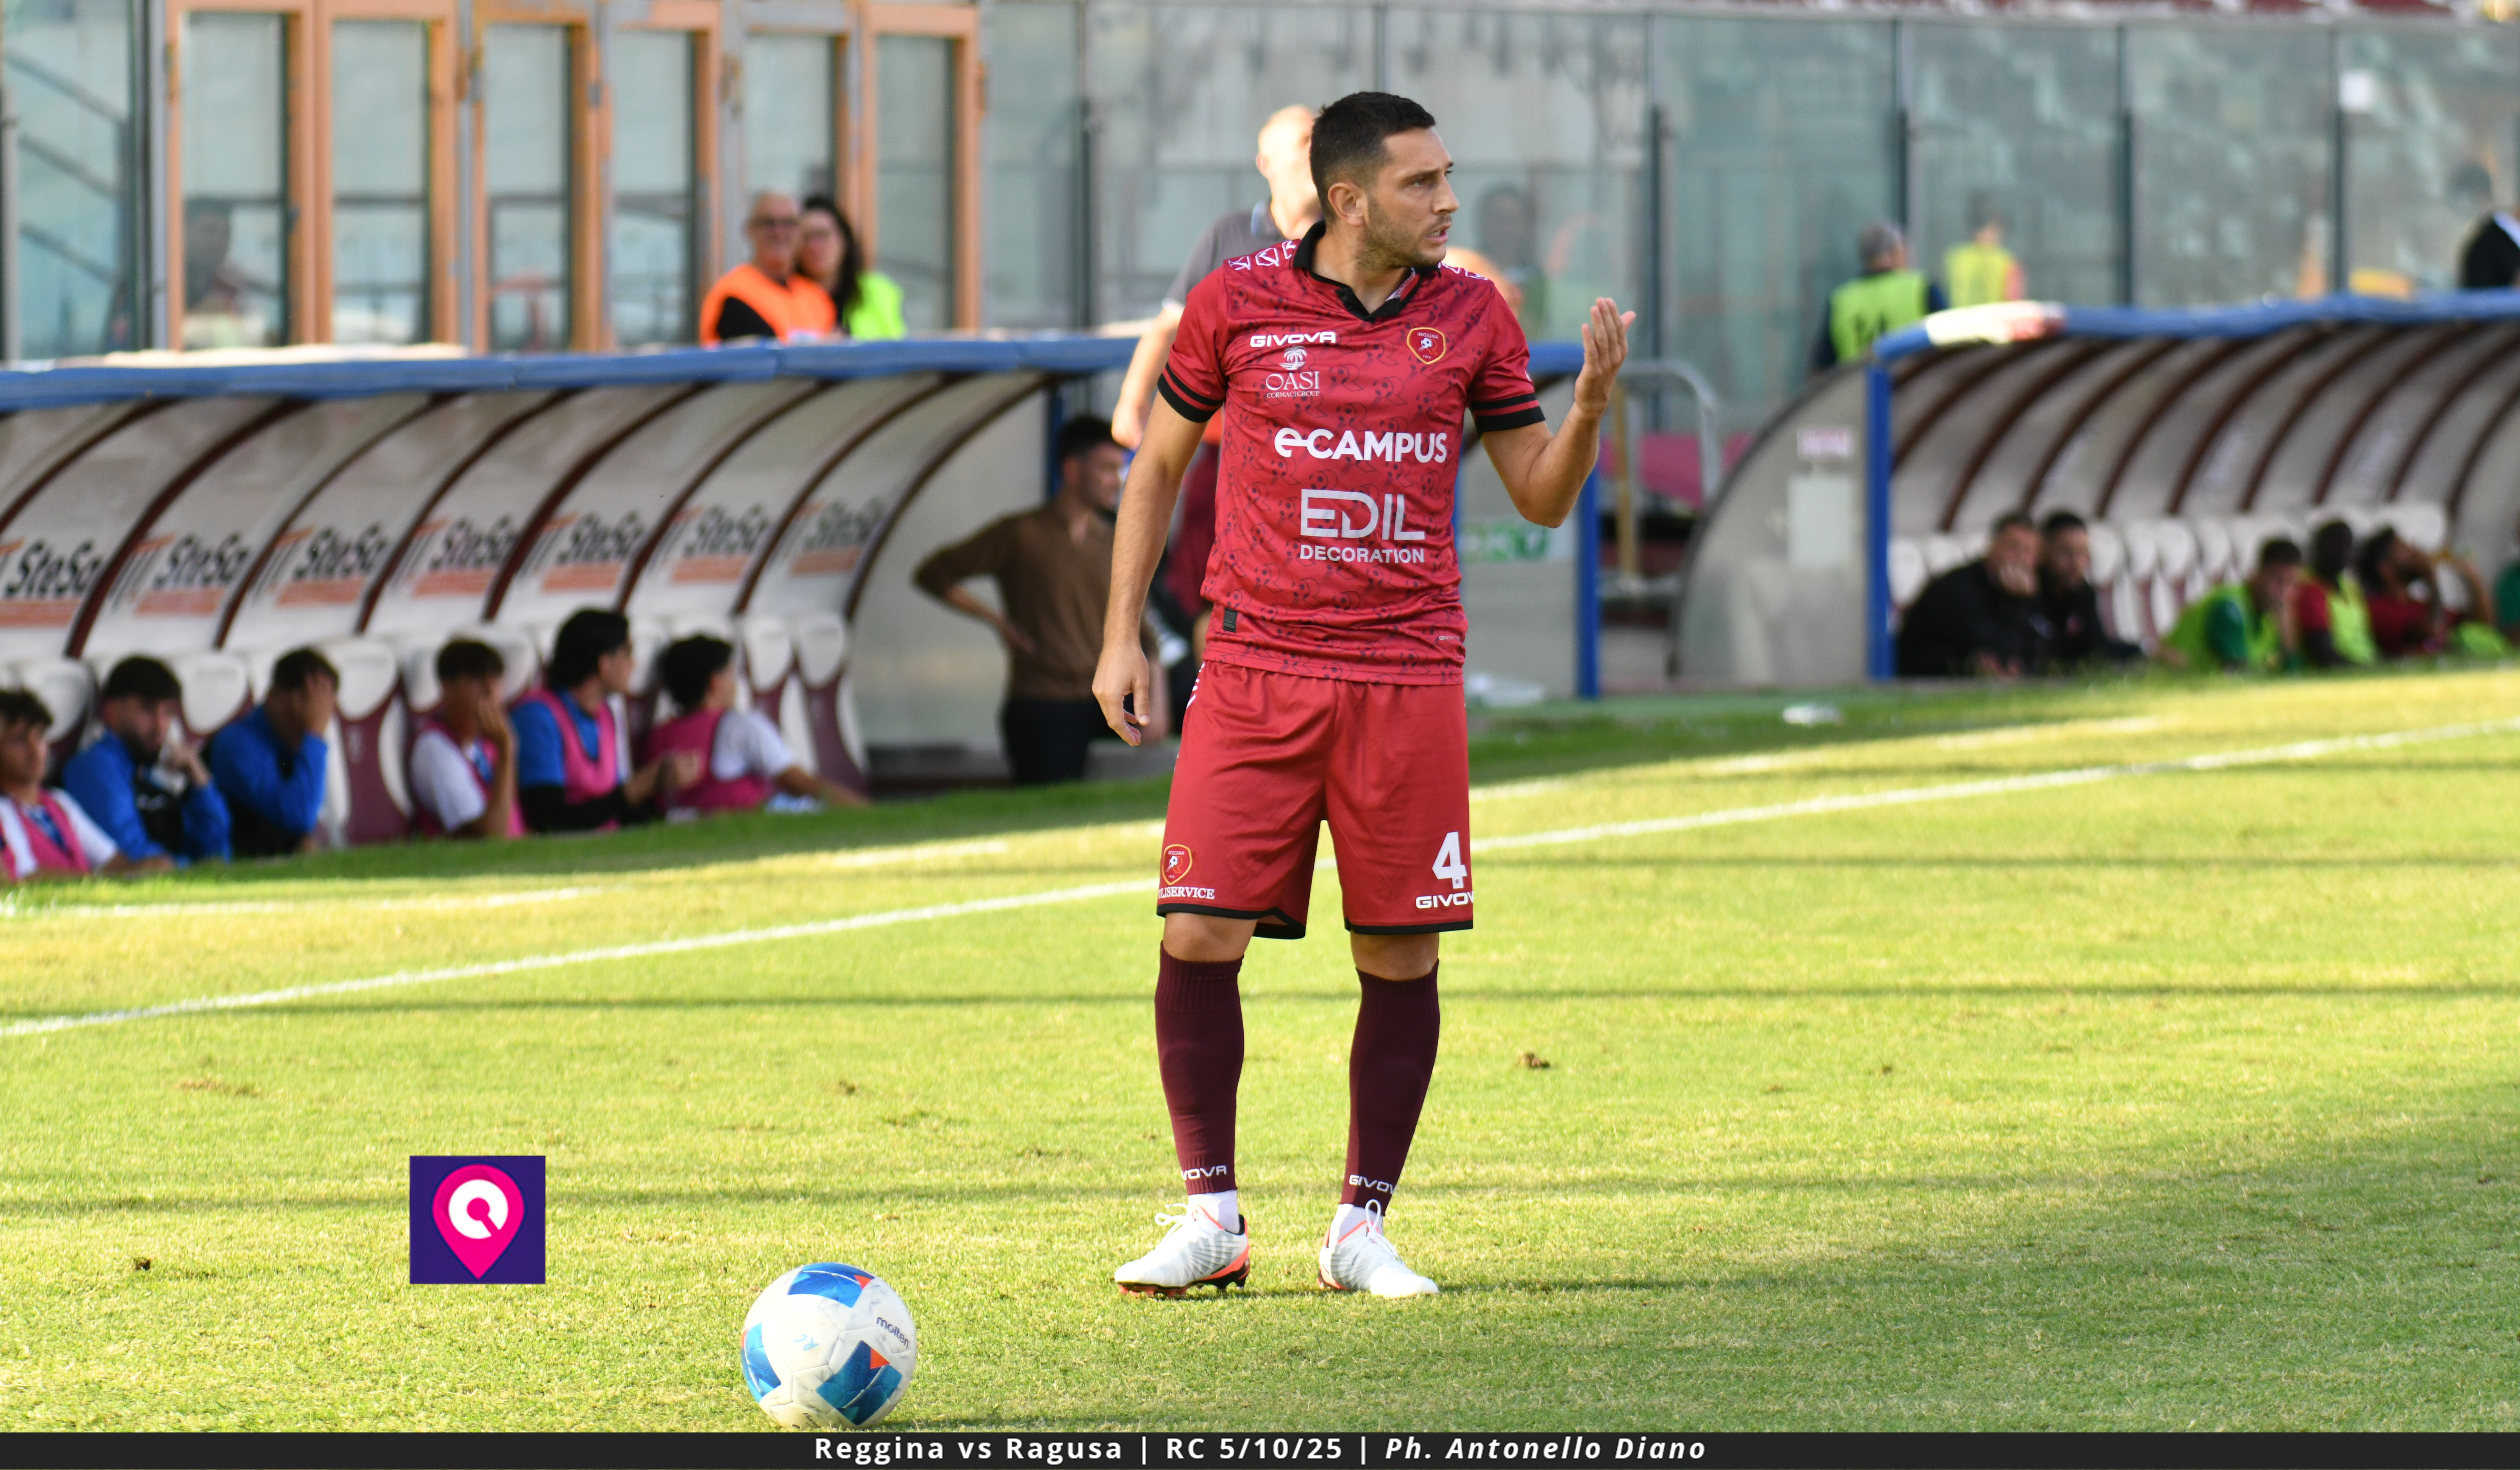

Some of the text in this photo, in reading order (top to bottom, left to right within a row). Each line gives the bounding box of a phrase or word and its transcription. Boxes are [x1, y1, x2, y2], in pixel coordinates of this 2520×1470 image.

[1250, 332, 1337, 347] GIVOVA
[1266, 371, 1320, 391] OASI
[1300, 489, 1425, 540] EDIL
[1300, 545, 1424, 563] DECORATION
[1432, 831, 1468, 889] 4
[876, 1317, 909, 1349] molten
